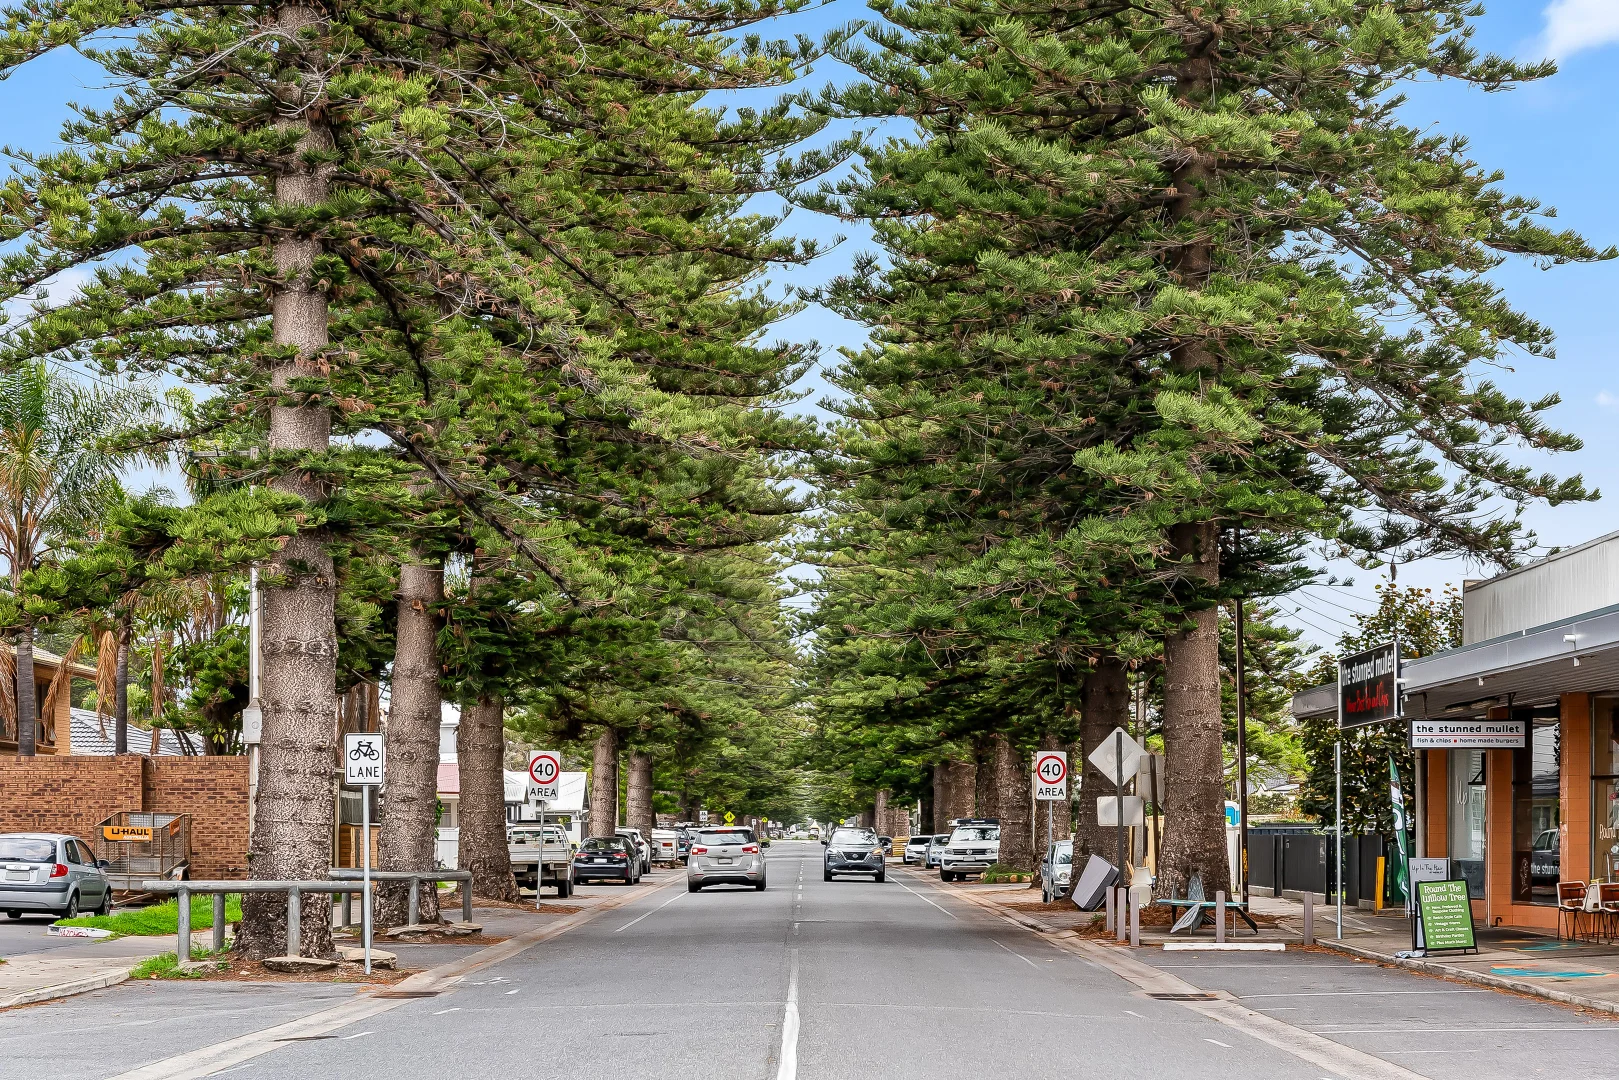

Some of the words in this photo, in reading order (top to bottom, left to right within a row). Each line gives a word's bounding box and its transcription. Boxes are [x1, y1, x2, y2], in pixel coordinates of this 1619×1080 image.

[1342, 664, 1351, 686] the
[1352, 655, 1375, 684] stunned
[1376, 650, 1394, 675] mullet
[1416, 725, 1434, 733] the
[1438, 725, 1482, 733] stunned
[1486, 725, 1520, 733] mullet
[349, 766, 380, 778] LANE
[534, 763, 554, 776] 40
[1041, 763, 1061, 776] 40
[529, 787, 557, 797] AREA
[1037, 787, 1065, 797] AREA
[1412, 864, 1420, 874] Up
[1531, 863, 1541, 874] the
[1424, 884, 1447, 894] Round
[1448, 883, 1461, 893] The
[1422, 894, 1447, 903] Willow
[1449, 893, 1466, 902] Tree
